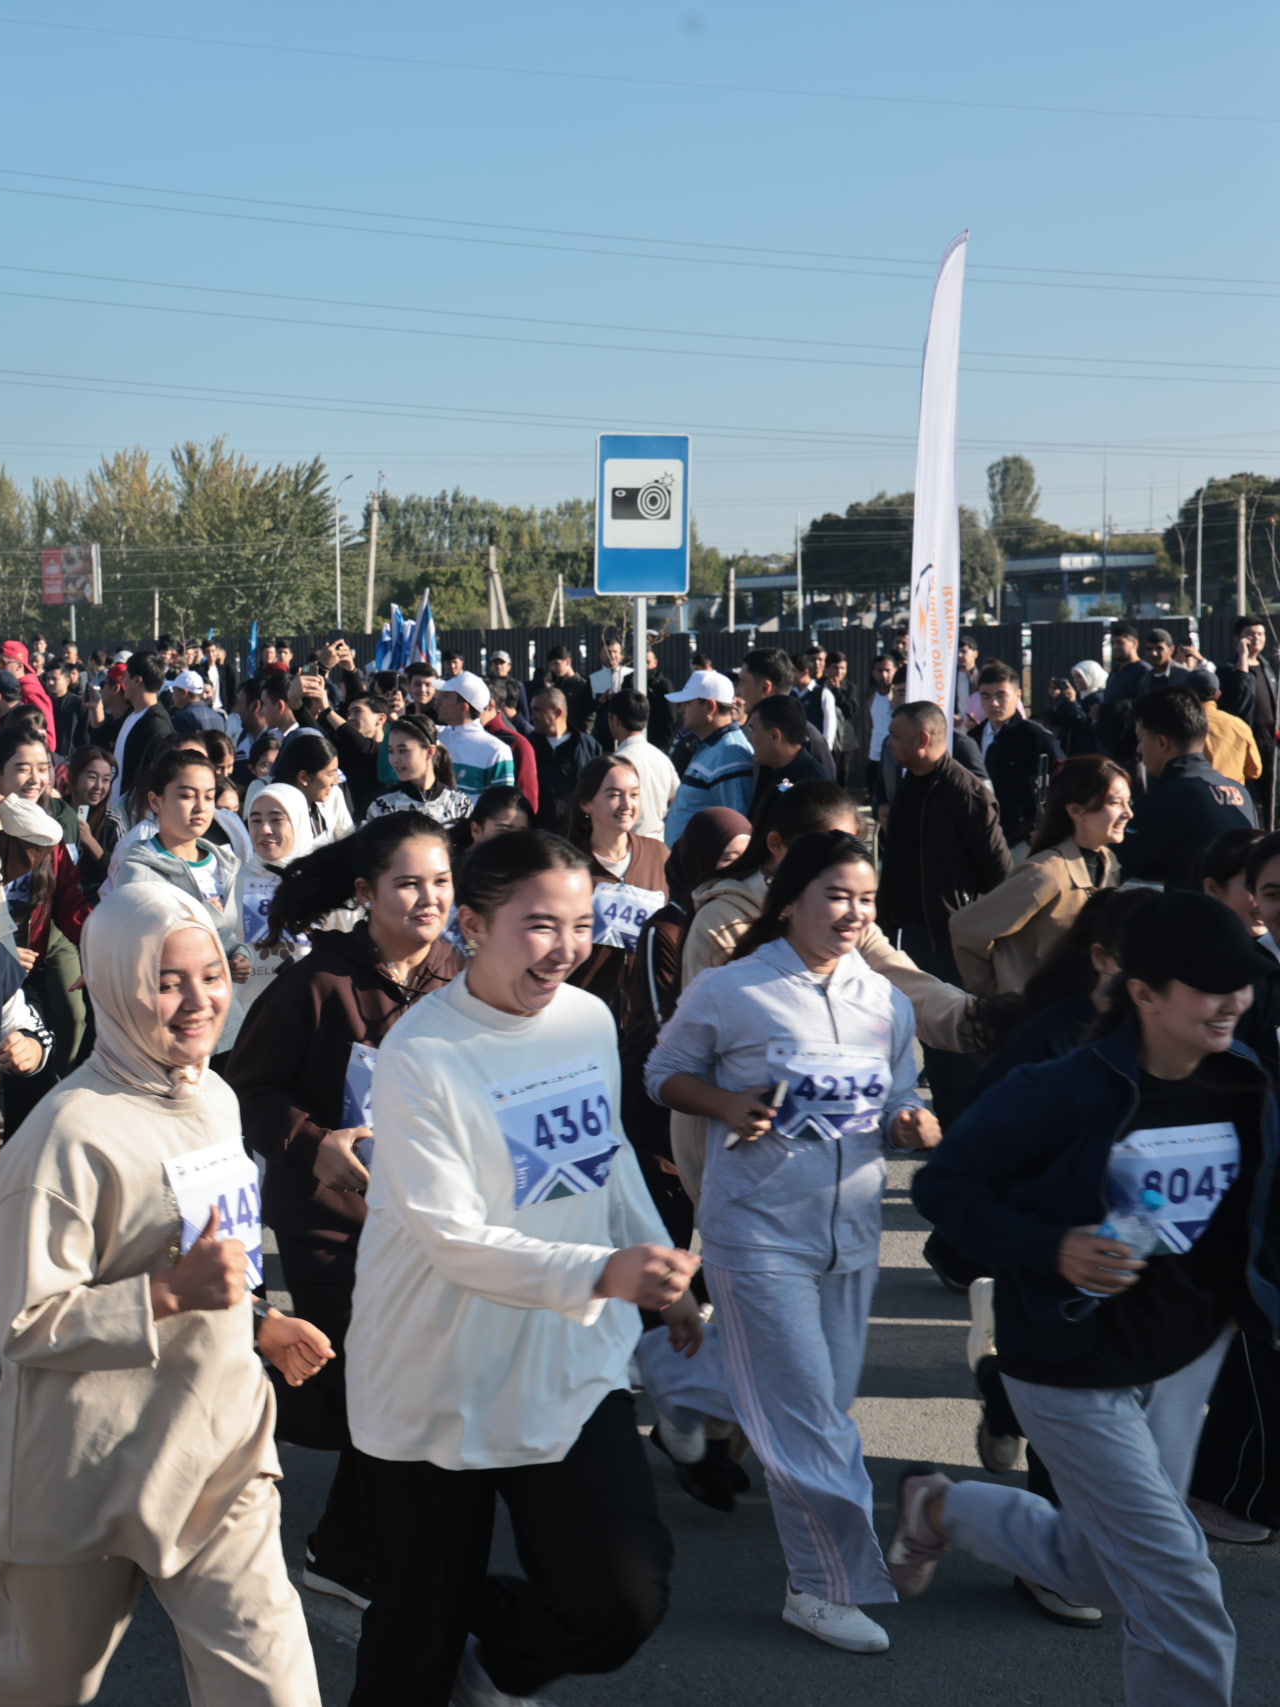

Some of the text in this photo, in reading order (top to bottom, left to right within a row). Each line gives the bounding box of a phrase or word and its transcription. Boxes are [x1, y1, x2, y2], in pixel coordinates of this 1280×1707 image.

[931, 649, 944, 691] OSIYO
[1208, 785, 1244, 806] UZB
[604, 902, 648, 928] 448
[794, 1073, 884, 1101] 4216
